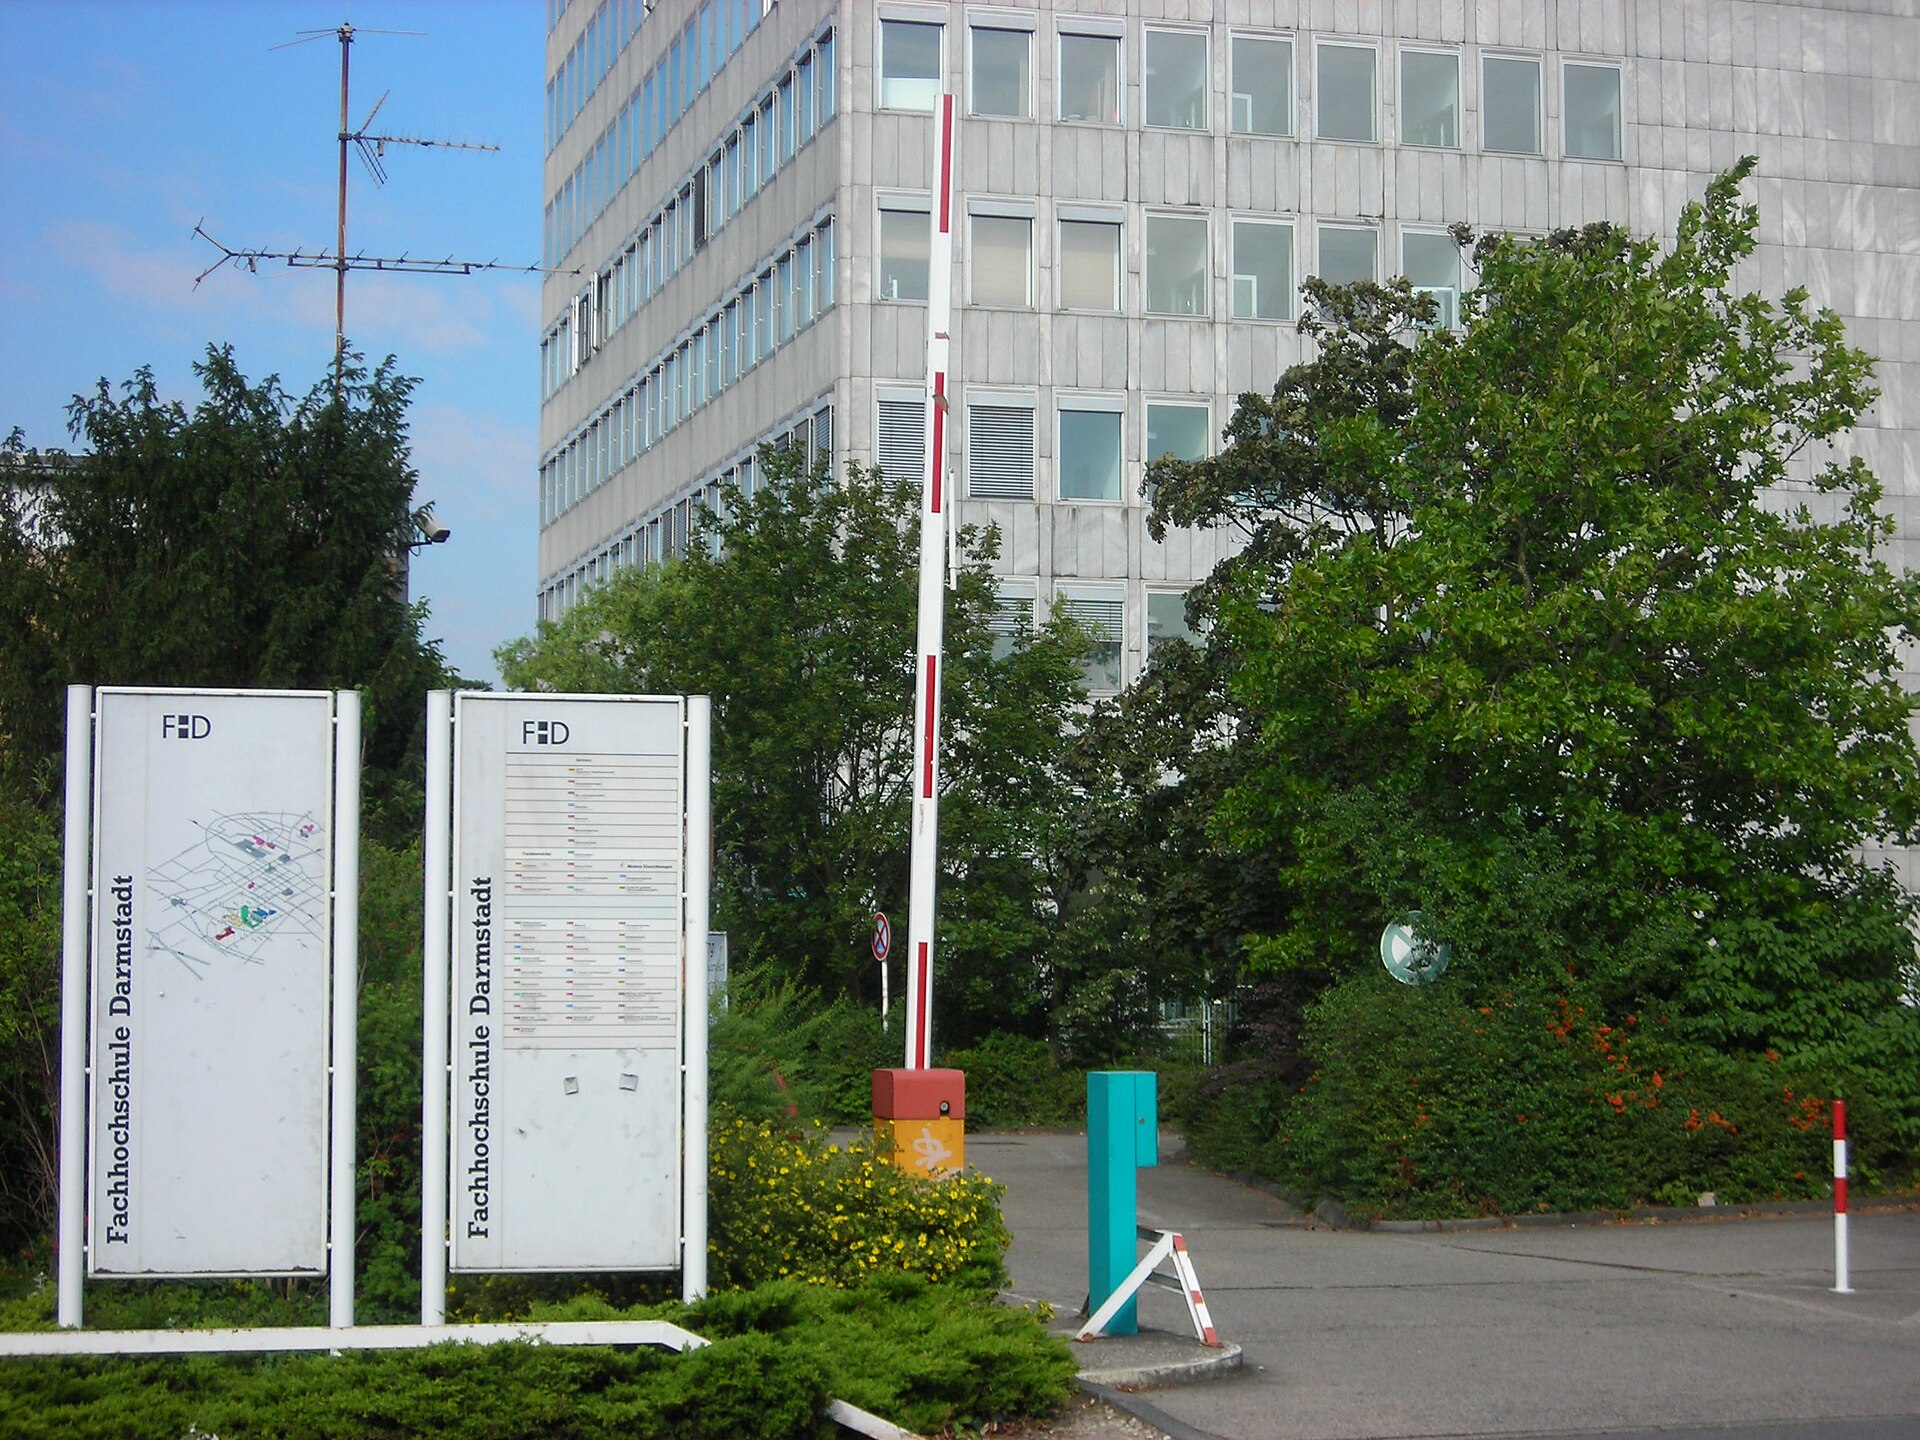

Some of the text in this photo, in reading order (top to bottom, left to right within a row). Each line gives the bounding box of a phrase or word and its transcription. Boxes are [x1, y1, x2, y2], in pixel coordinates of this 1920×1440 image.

[106, 875, 133, 1245] Fachhochschule Darmstadt
[467, 876, 492, 1239] Fachhochschule Darmstadt
